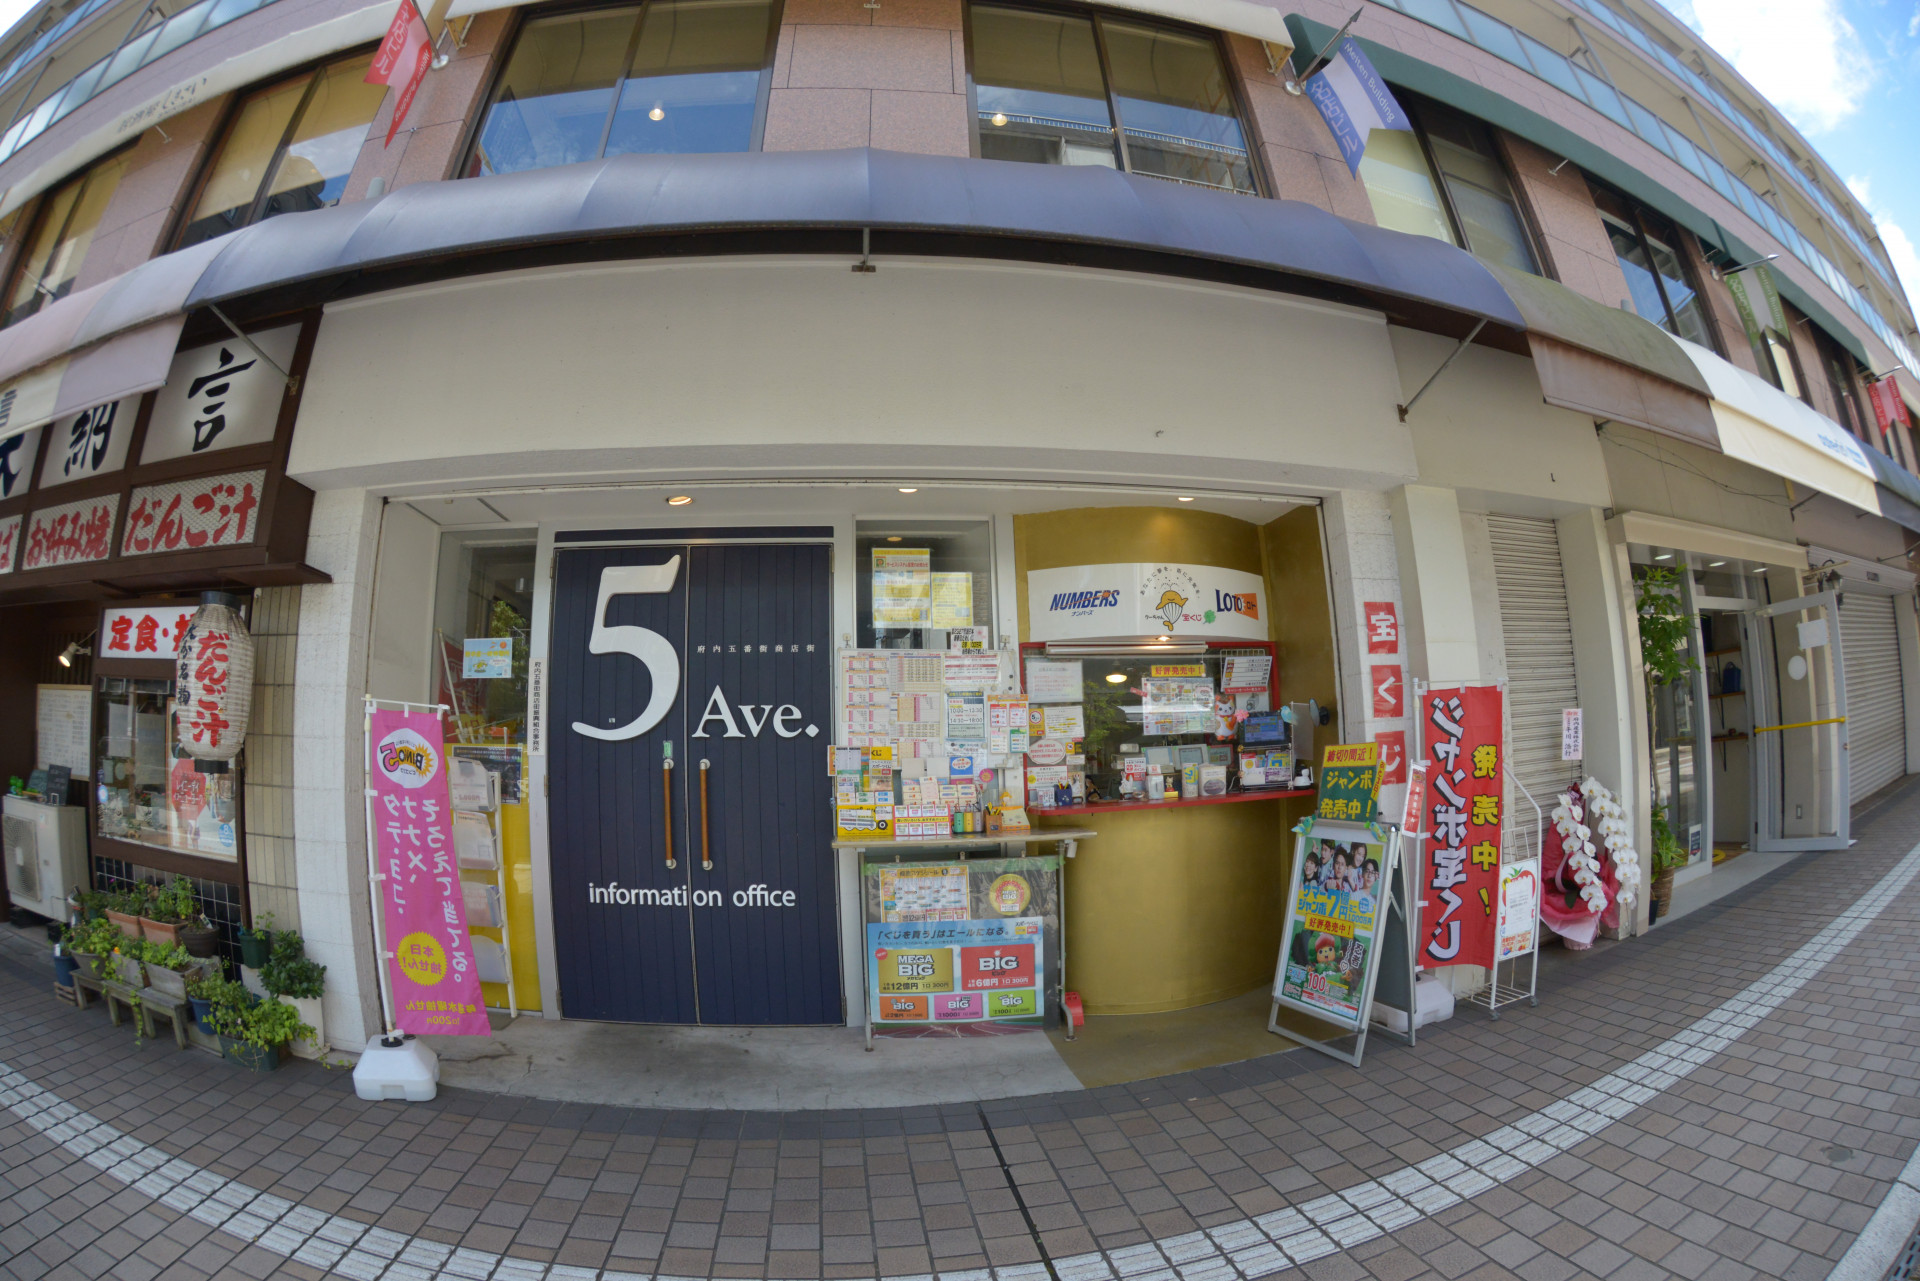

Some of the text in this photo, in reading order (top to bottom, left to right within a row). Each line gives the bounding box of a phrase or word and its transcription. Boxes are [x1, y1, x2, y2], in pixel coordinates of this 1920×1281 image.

[1344, 43, 1395, 123] Meiten Building
[1310, 81, 1358, 158] 名店ビル
[124, 482, 258, 553] だんご汁
[26, 505, 111, 567] お好み焼
[1050, 590, 1119, 612] NUMBERS
[1215, 589, 1242, 612] LOTO
[1246, 603, 1257, 611] ロト
[1071, 609, 1094, 617] ナンバーズ
[1182, 613, 1202, 622] 宝くじ
[571, 554, 681, 741] 5
[696, 644, 816, 653] 府内五番街商店街
[1155, 667, 1202, 676] 好評発売中！
[191, 629, 230, 749] だんご汁
[1370, 612, 1401, 772] 宝くじ
[691, 684, 820, 739] Ave.
[1326, 769, 1373, 790] ジャンボ
[1319, 798, 1373, 820] 発売中！
[588, 882, 797, 908] information office
[1327, 888, 1340, 918] 7
[878, 926, 1009, 941] 「くじを買う」はエールになる。
[897, 955, 933, 964] MEGA
[979, 955, 1019, 972] BIG
[898, 964, 935, 977] BIG
[891, 982, 919, 991] 12億円
[976, 978, 999, 988] 6億円
[947, 1000, 970, 1009] BIG
[1002, 996, 1023, 1005] BIG
